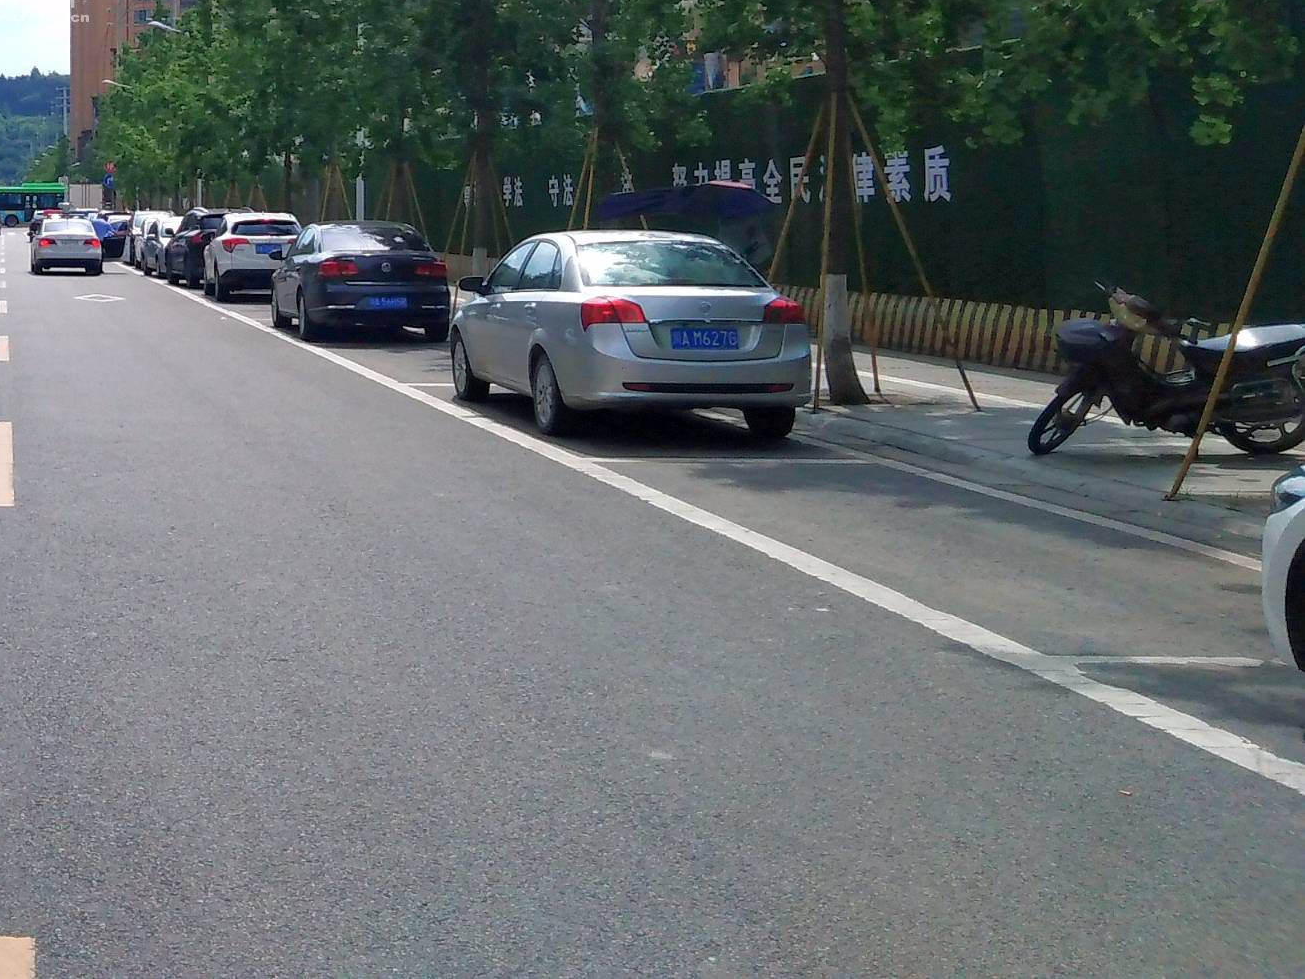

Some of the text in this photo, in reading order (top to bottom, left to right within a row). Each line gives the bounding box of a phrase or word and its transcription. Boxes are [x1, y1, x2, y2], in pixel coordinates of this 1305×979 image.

[502, 175, 524, 208] 学法
[548, 173, 574, 208] 守法
[672, 145, 952, 205] 努力提高全民律素质
